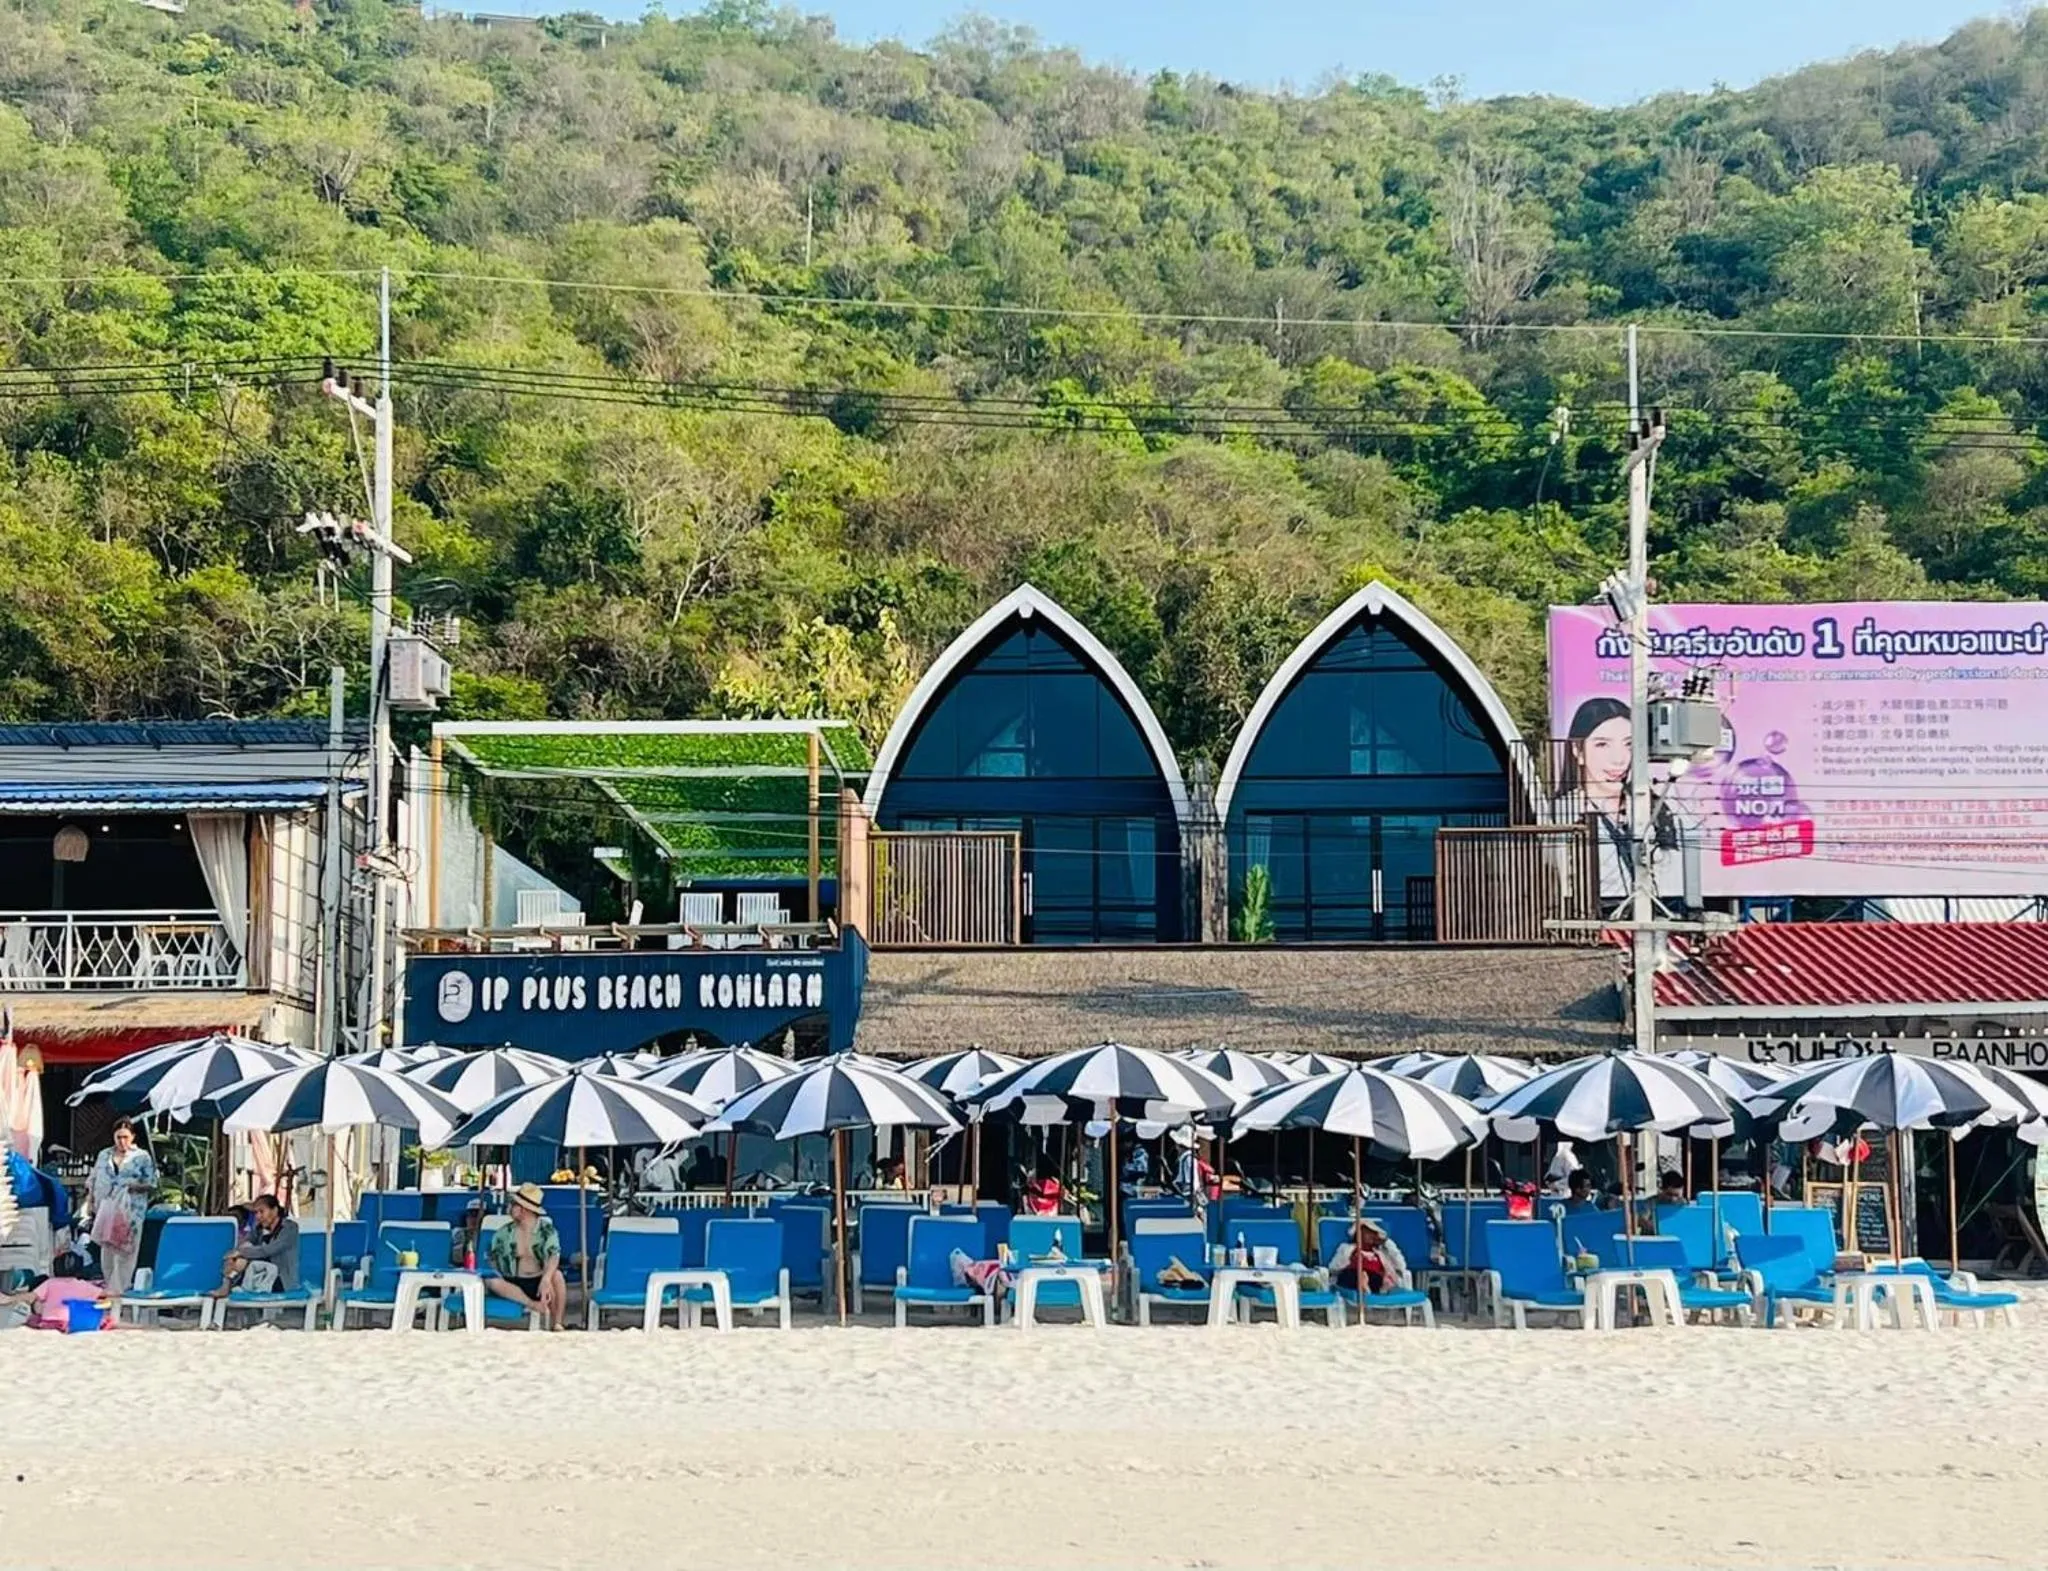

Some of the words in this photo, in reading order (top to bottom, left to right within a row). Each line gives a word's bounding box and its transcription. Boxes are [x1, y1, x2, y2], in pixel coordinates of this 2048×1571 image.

[1813, 617, 1844, 659] 1
[482, 976, 509, 1012] IP
[522, 975, 586, 1011] PLUS
[598, 974, 681, 1010] BEACH
